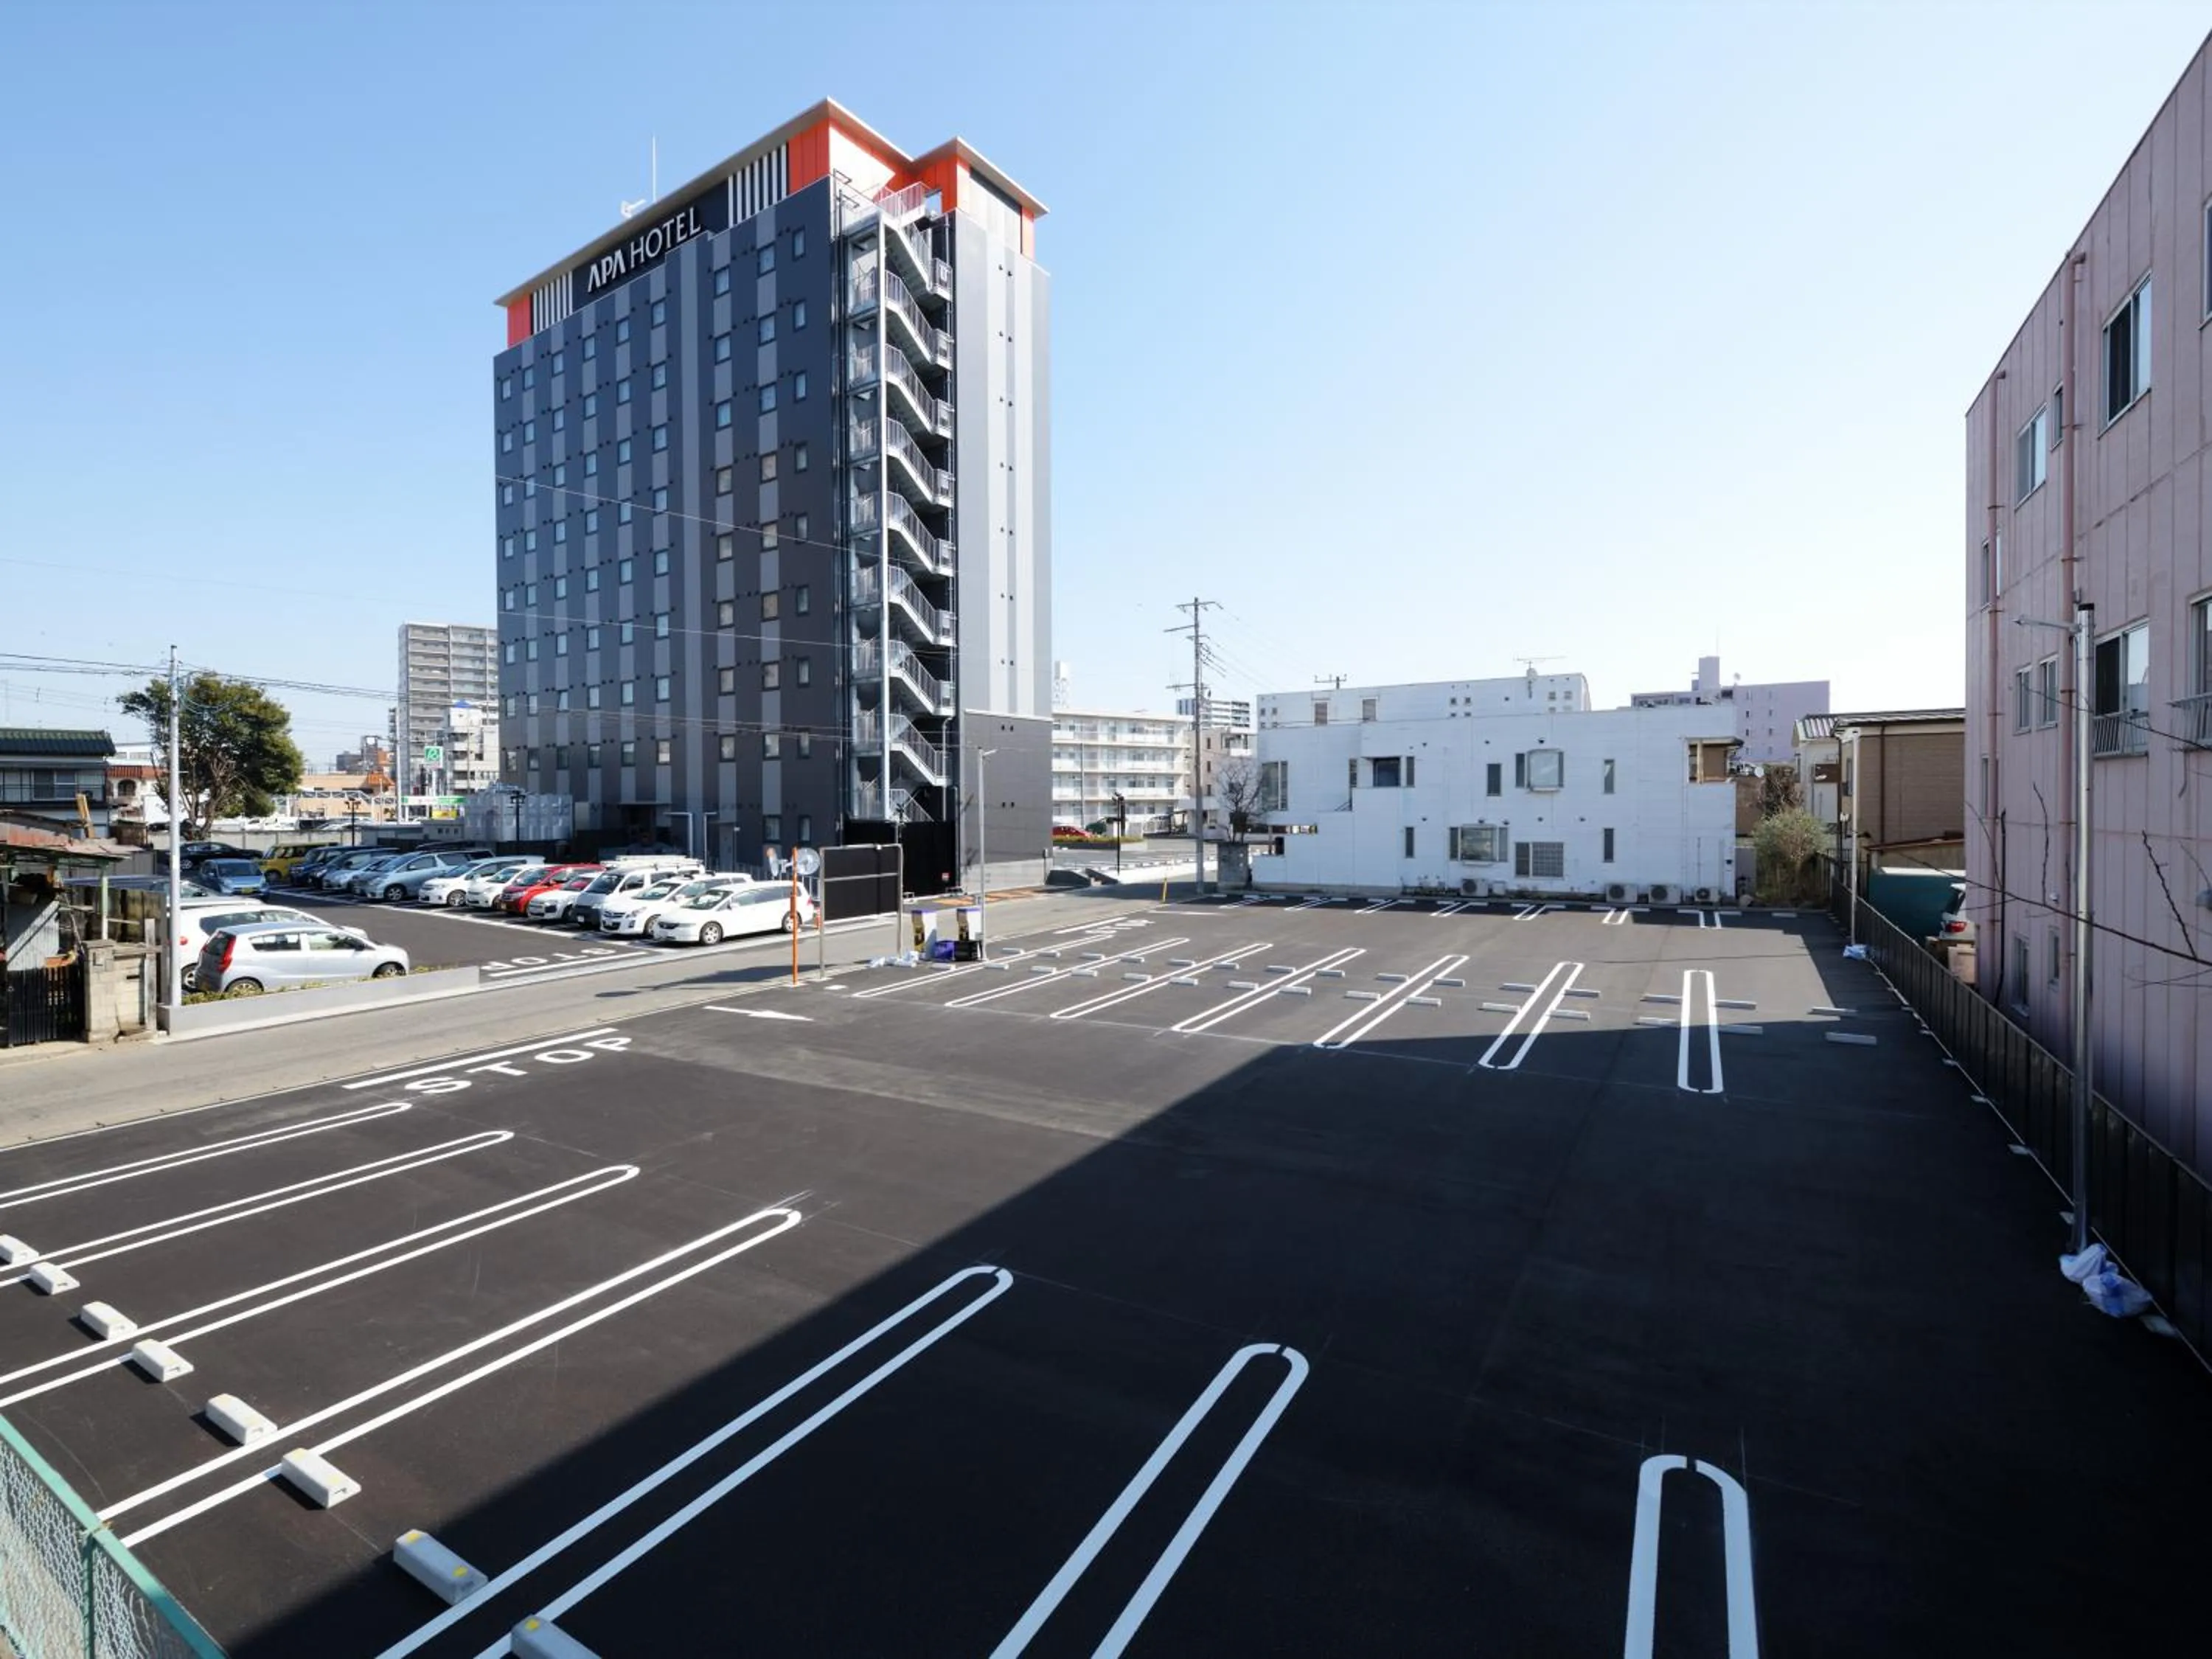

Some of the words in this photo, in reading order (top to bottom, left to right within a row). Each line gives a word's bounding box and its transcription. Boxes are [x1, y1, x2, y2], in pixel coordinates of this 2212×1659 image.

[588, 249, 626, 293] APA
[630, 206, 701, 269] HOTEL
[481, 947, 616, 971] STOP
[404, 1037, 633, 1093] STOP
